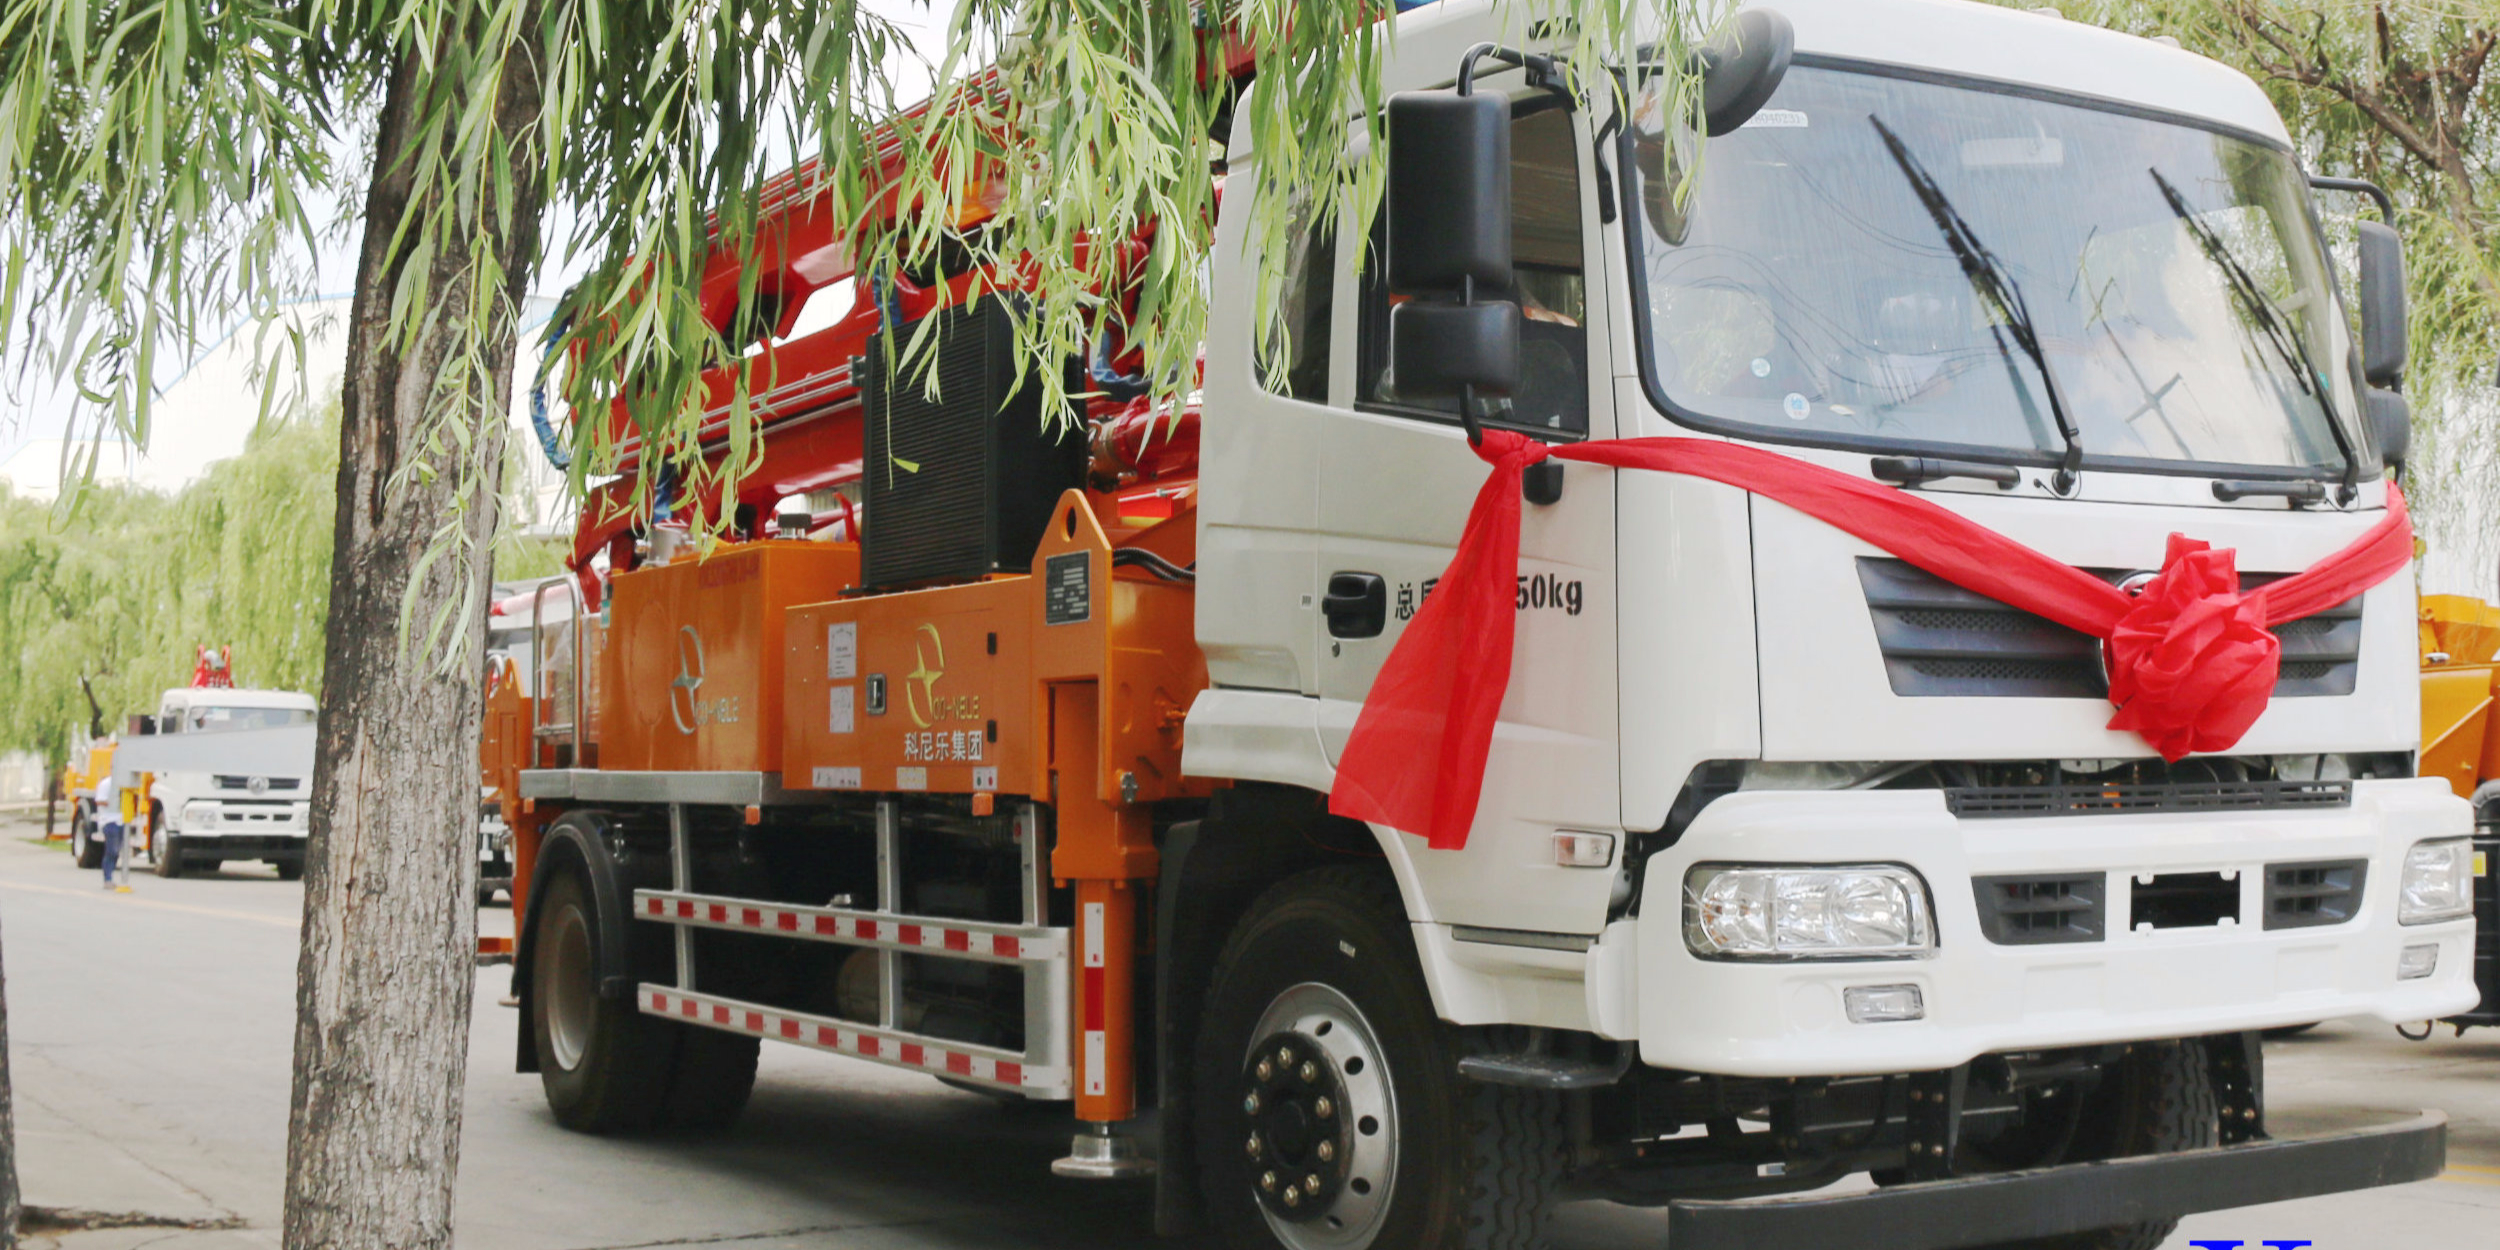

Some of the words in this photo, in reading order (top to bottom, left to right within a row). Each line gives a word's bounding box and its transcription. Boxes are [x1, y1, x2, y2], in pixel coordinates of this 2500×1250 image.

[904, 730, 983, 761] 科尼乐集团
